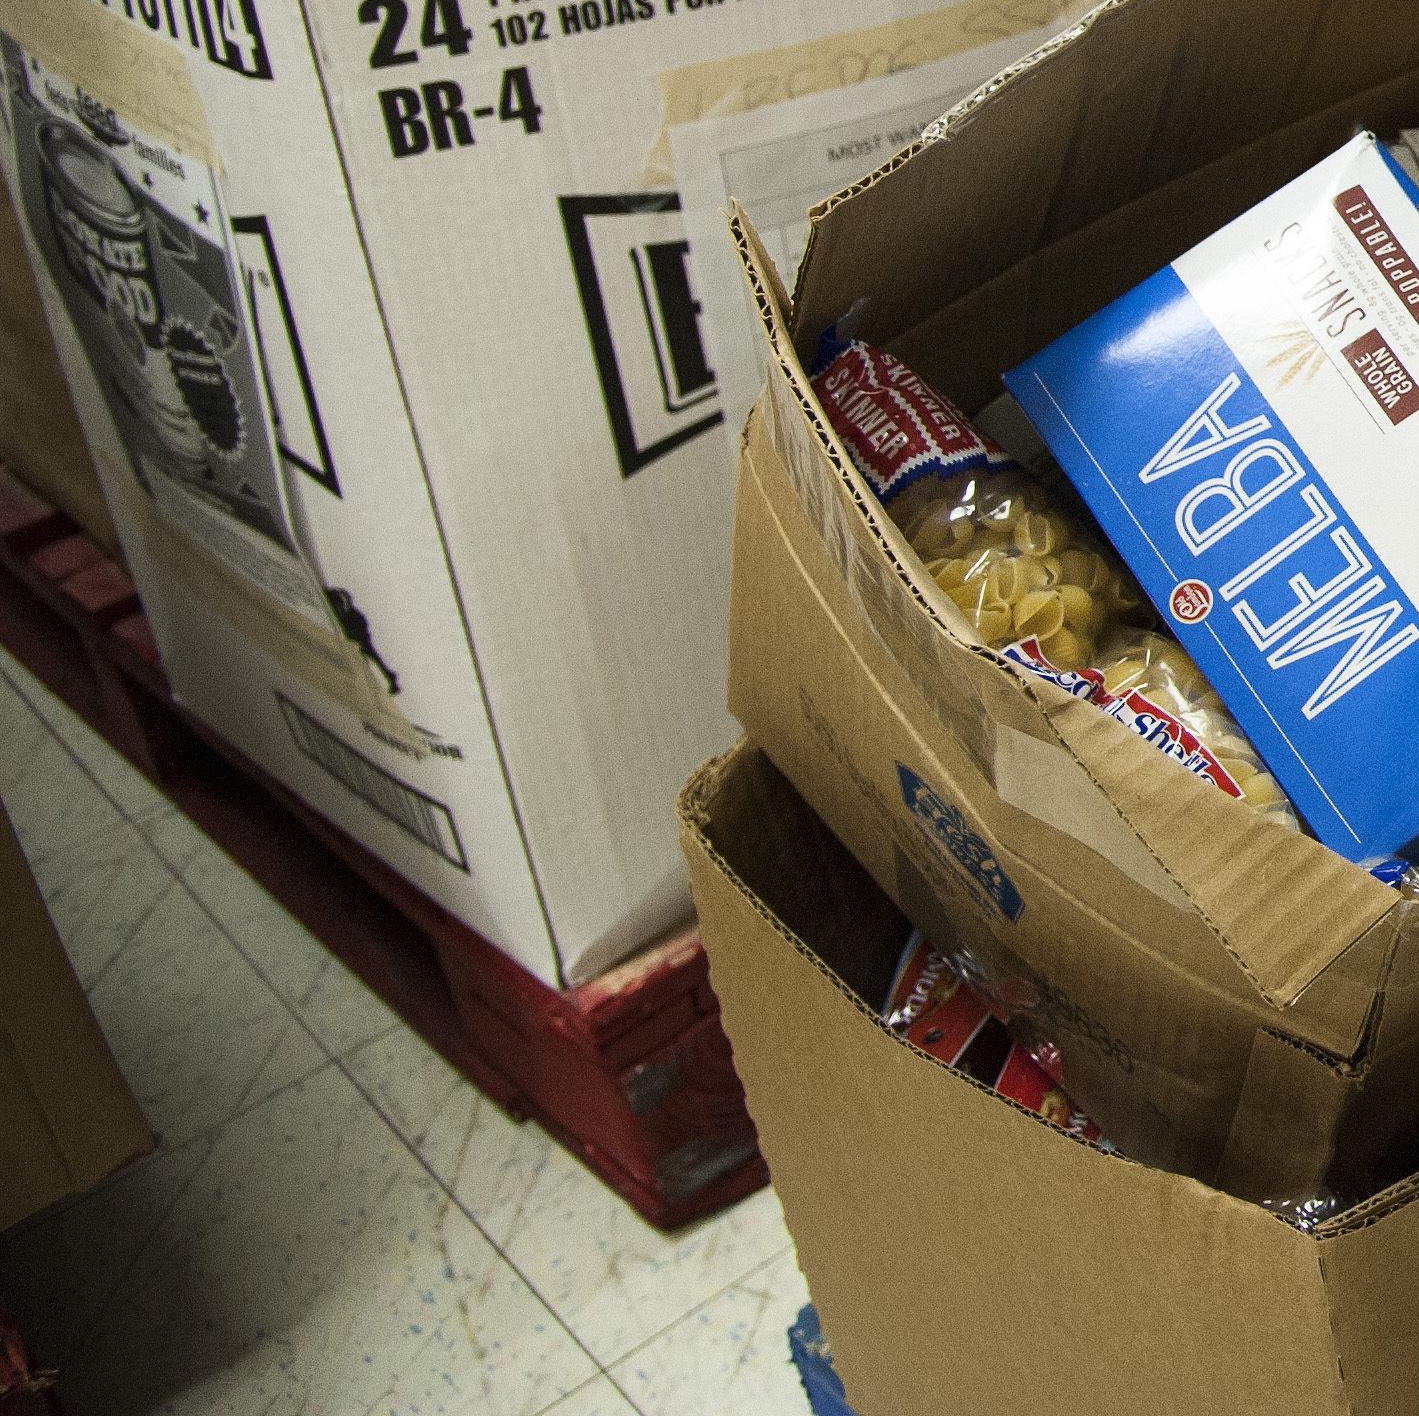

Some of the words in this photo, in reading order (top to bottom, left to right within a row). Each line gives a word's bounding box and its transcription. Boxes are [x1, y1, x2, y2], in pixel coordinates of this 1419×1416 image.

[489, 10, 550, 48] 102
[377, 65, 544, 159] BR-4
[826, 134, 881, 163] MOST
[1263, 221, 1367, 340] SNACKS
[878, 351, 961, 445] SKINNER
[1353, 354, 1397, 411] WHOLE
[1371, 345, 1414, 396] GRAIN
[822, 367, 910, 466] SKINNER
